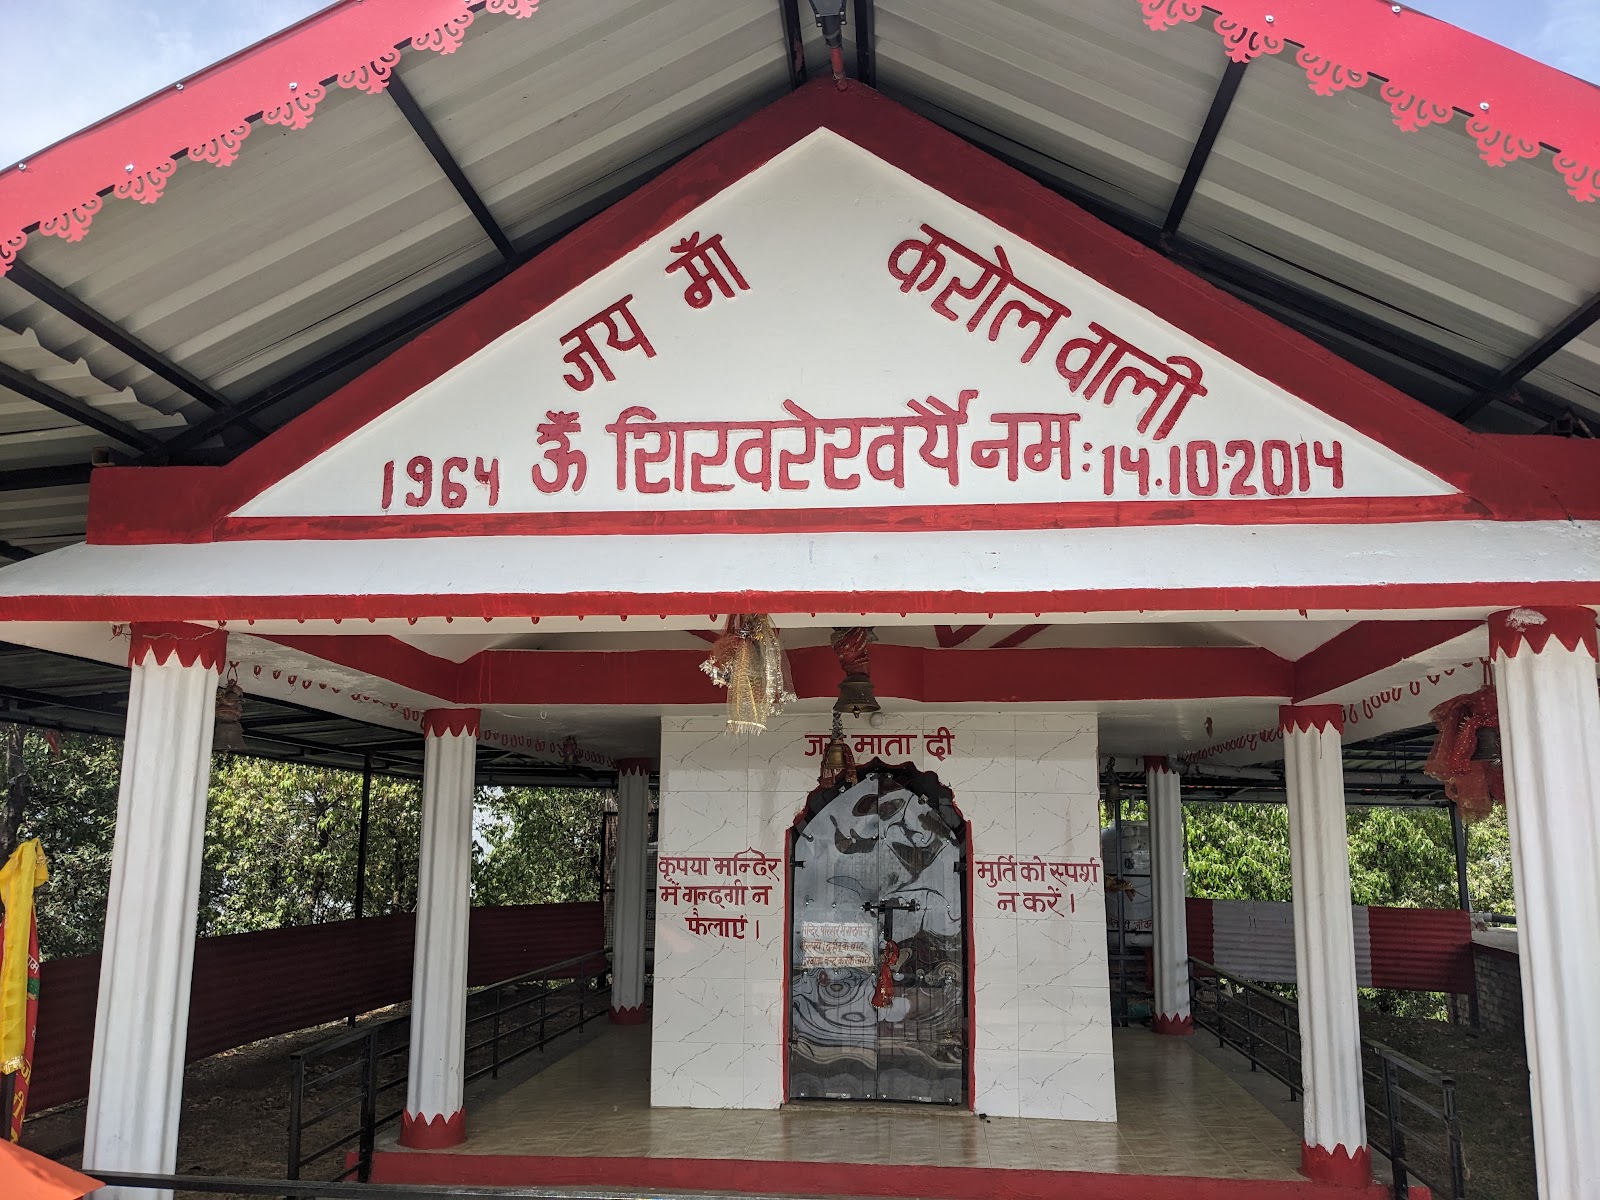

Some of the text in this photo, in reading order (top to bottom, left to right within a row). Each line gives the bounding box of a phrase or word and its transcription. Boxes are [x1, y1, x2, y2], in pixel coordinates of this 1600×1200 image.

[560, 294, 656, 391] जय
[888, 223, 1208, 440] करोल वाली
[381, 455, 500, 509] 1964
[805, 727, 955, 761] ज माता दी
[658, 846, 782, 882] कृपया मन्दिर
[1018, 856, 1047, 882] को
[1047, 857, 1100, 887] स्पर्श
[658, 879, 773, 909] में गन्दगी न
[997, 892, 1020, 912] न
[1022, 886, 1064, 918] करें
